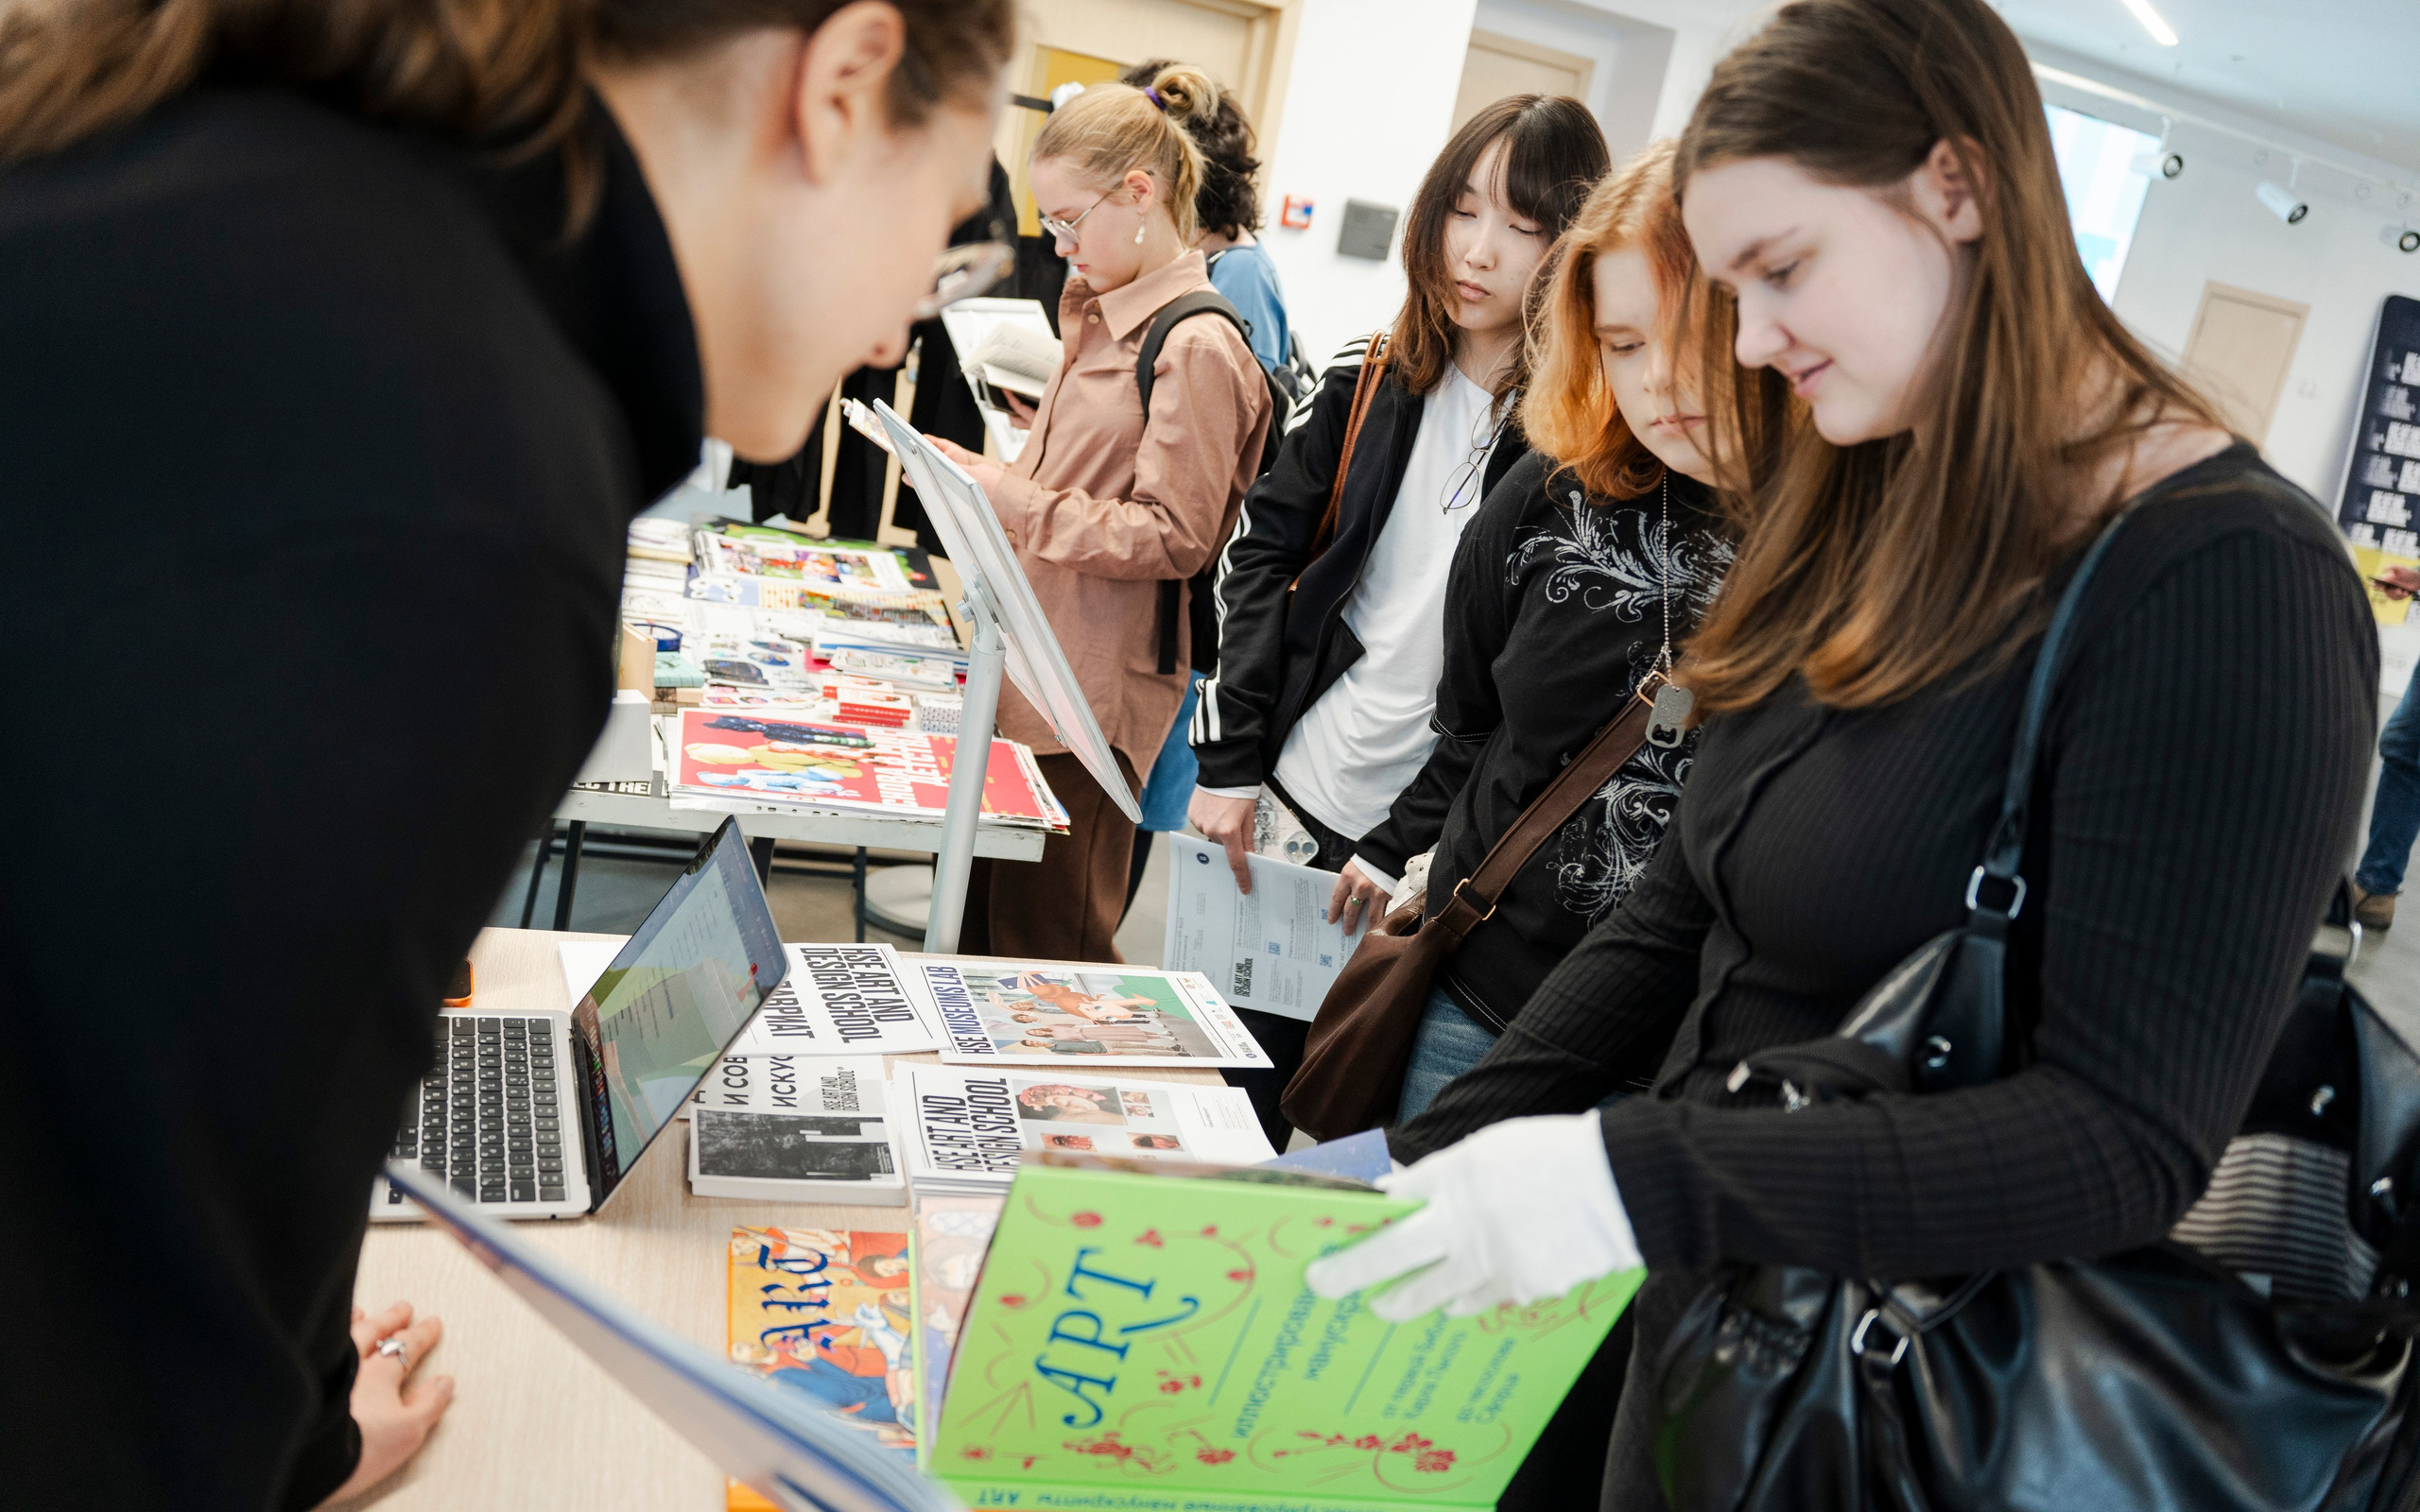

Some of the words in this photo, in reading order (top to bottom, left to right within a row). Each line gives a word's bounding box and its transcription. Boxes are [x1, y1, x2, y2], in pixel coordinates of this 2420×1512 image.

[873, 767, 918, 806] СНОВА
[800, 948, 857, 990] DESIGN
[839, 948, 887, 970] HSE
[1236, 962, 1244, 973] AND
[1243, 957, 1253, 978] SCHOOL
[852, 971, 901, 995] ART
[925, 966, 962, 986] LAB
[1235, 973, 1243, 985] ART
[1234, 985, 1242, 996] HSE
[1241, 978, 1252, 998] DESIGN
[821, 992, 883, 1043] SCHOOL
[864, 997, 915, 1022] AND
[933, 987, 985, 1035] MUSEUMS
[954, 1036, 995, 1055] HSE
[821, 1076, 838, 1088] AND
[838, 1071, 856, 1091] SCHOOL
[723, 1093, 749, 1105] И
[821, 1089, 840, 1100] ART
[840, 1092, 859, 1111] DESIGN
[964, 1077, 1018, 1133] SCHOOL
[823, 1100, 841, 1111] HSE
[922, 1095, 970, 1125] AND
[926, 1125, 977, 1150] ART
[932, 1150, 985, 1172] HSE
[975, 1135, 1024, 1174] DESIGN
[1304, 1289, 1361, 1381] манускри
